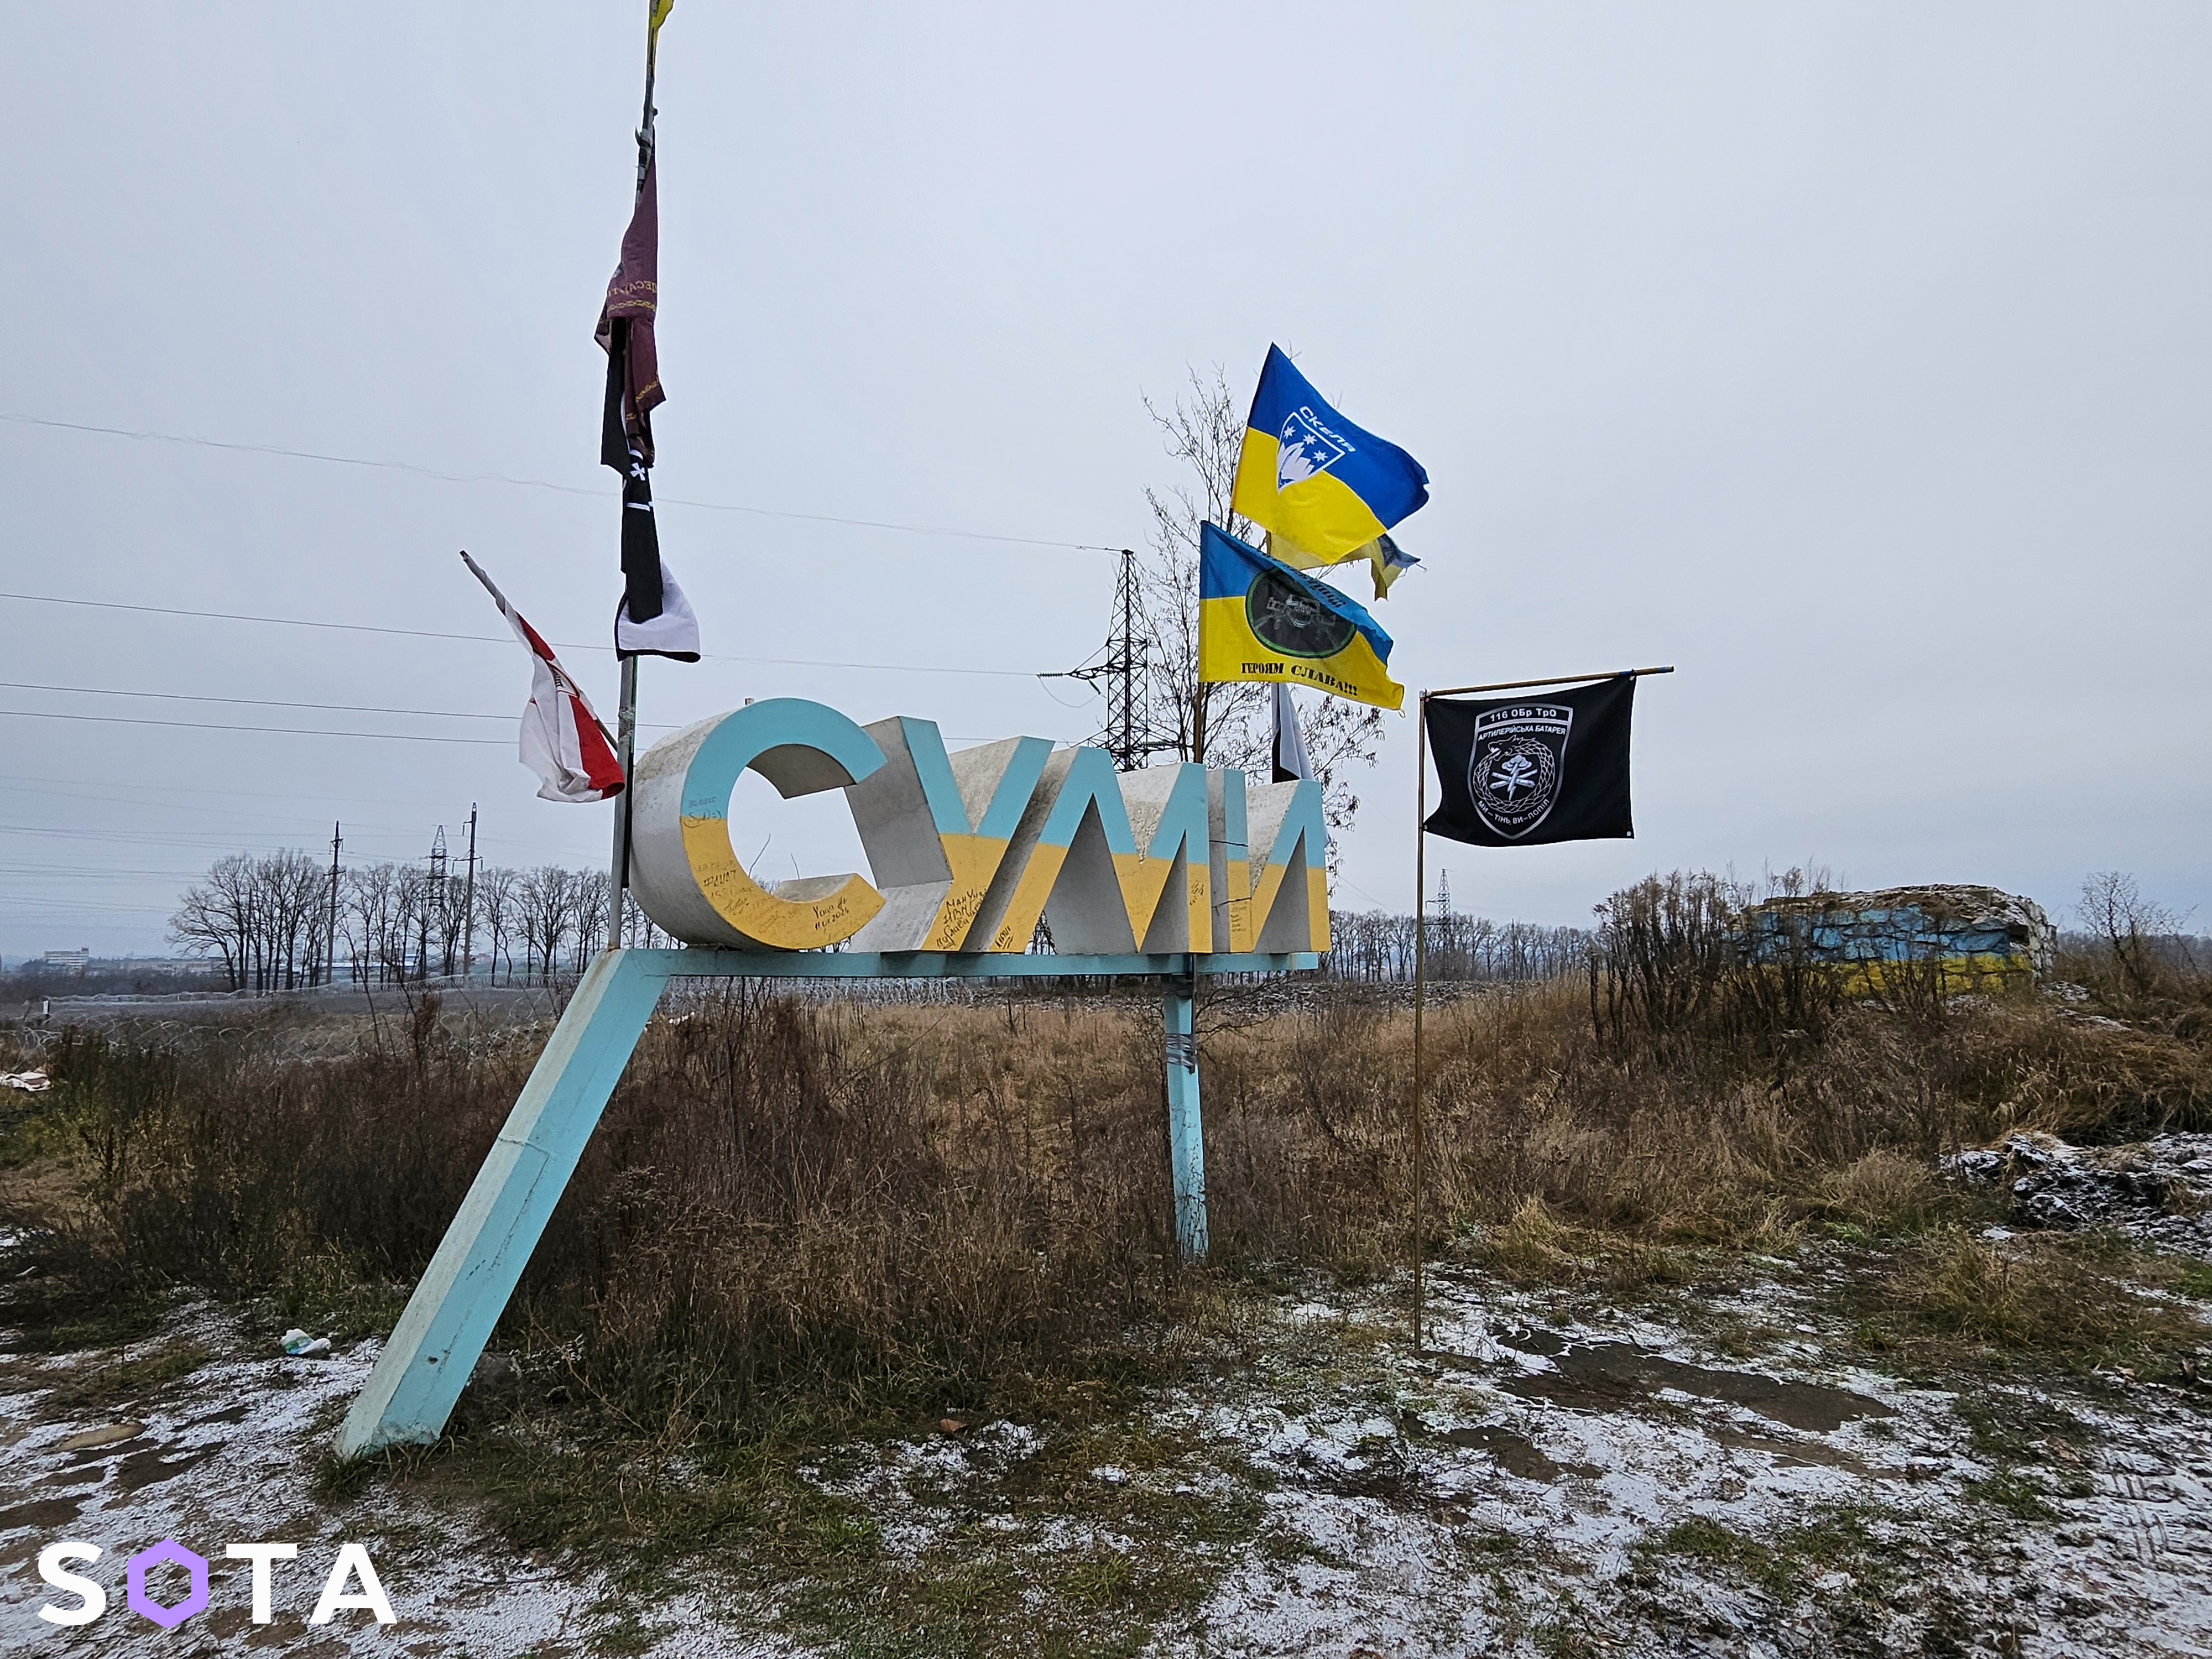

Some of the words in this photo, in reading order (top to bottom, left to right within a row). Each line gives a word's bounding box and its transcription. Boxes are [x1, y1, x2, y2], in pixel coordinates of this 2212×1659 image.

[1241, 663, 1284, 674] ГЕРОЯМ
[1291, 665, 1358, 696] СЛАВА!!!
[1490, 711, 1508, 722] 116
[1511, 708, 1532, 718] ОБр
[1536, 708, 1557, 718] ТрО
[1535, 725, 1566, 735] БАТАРЕЯ
[1478, 800, 1489, 813] МИ
[678, 697, 1331, 953] СУМИ
